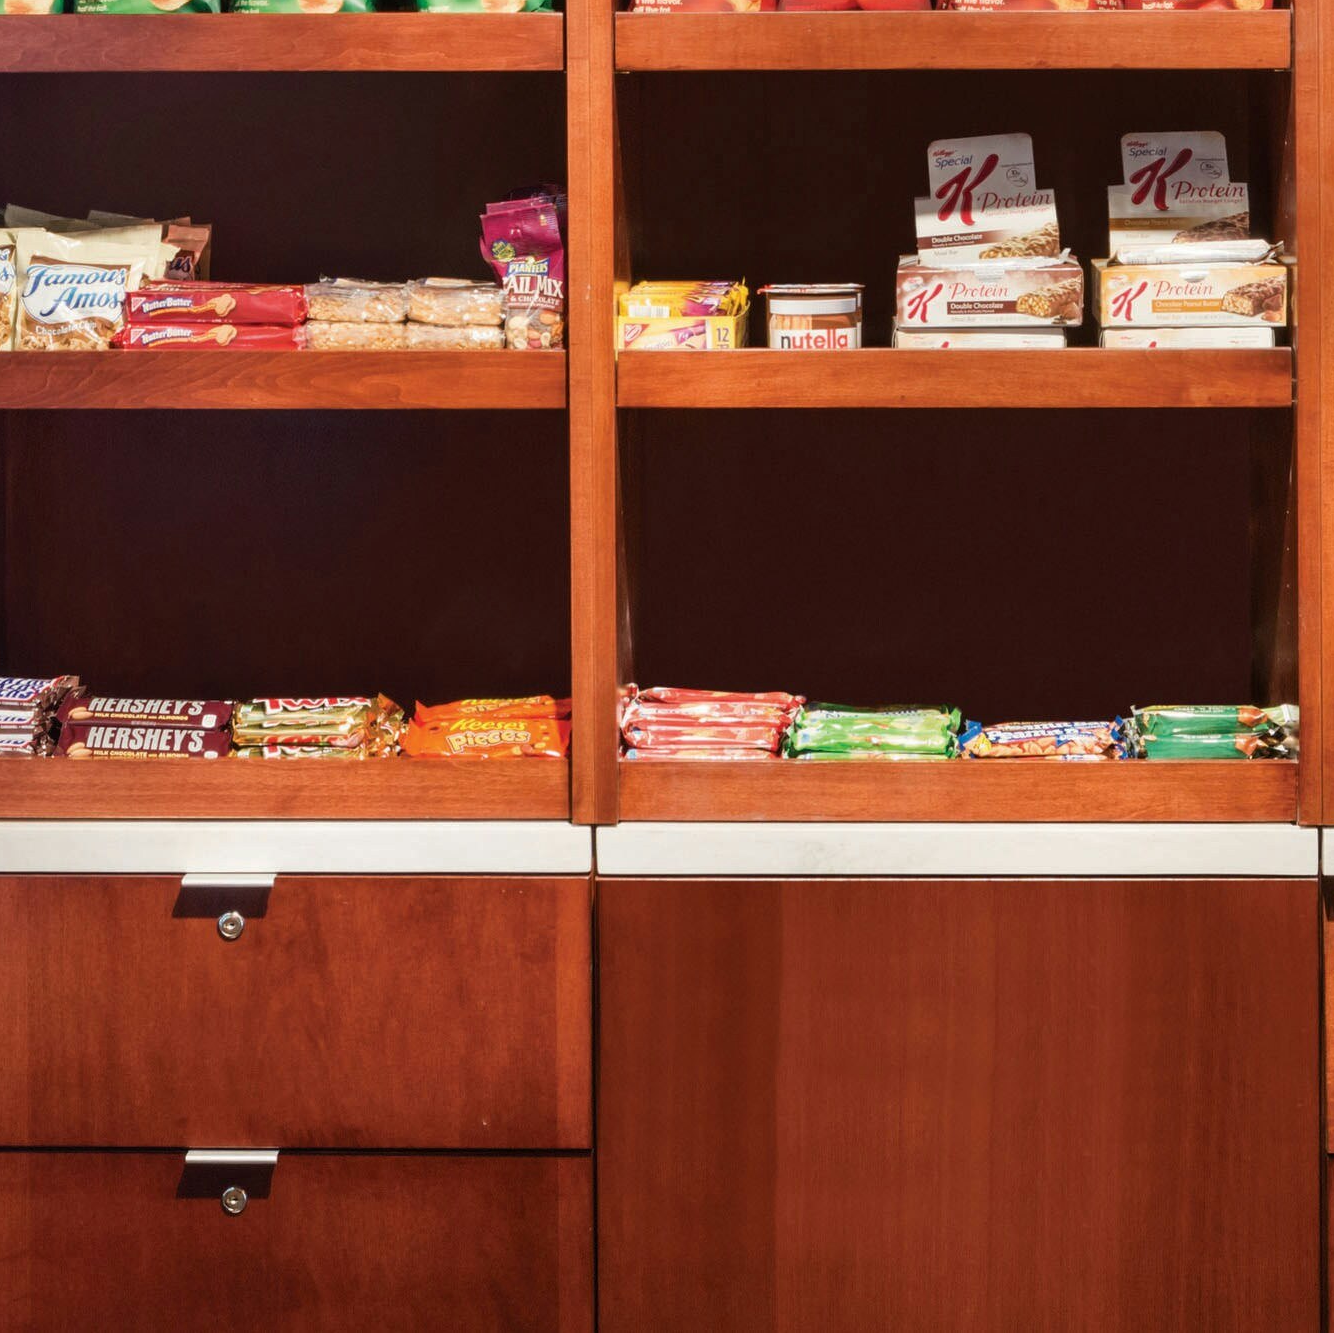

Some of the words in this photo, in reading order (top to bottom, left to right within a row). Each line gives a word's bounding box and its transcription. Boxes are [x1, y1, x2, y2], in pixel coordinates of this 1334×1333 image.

[935, 155, 972, 169] Special
[1129, 148, 1166, 158] Special
[1129, 148, 1193, 211] K
[935, 154, 999, 226] K
[1171, 181, 1244, 199] Protein
[977, 192, 1051, 212] Protein
[22, 264, 126, 298] Famous
[538, 276, 563, 298] MIX
[949, 283, 1009, 299] Protein
[1153, 281, 1212, 297] Protein
[39, 289, 119, 317] Amos
[908, 284, 943, 323] K
[1112, 281, 1148, 321] K
[36, 323, 76, 336] Chocolate
[717, 328, 728, 341] 12
[781, 328, 848, 348] nutella
[88, 698, 205, 715] HERSHEY'S
[86, 727, 205, 752] HERSHEY'S
